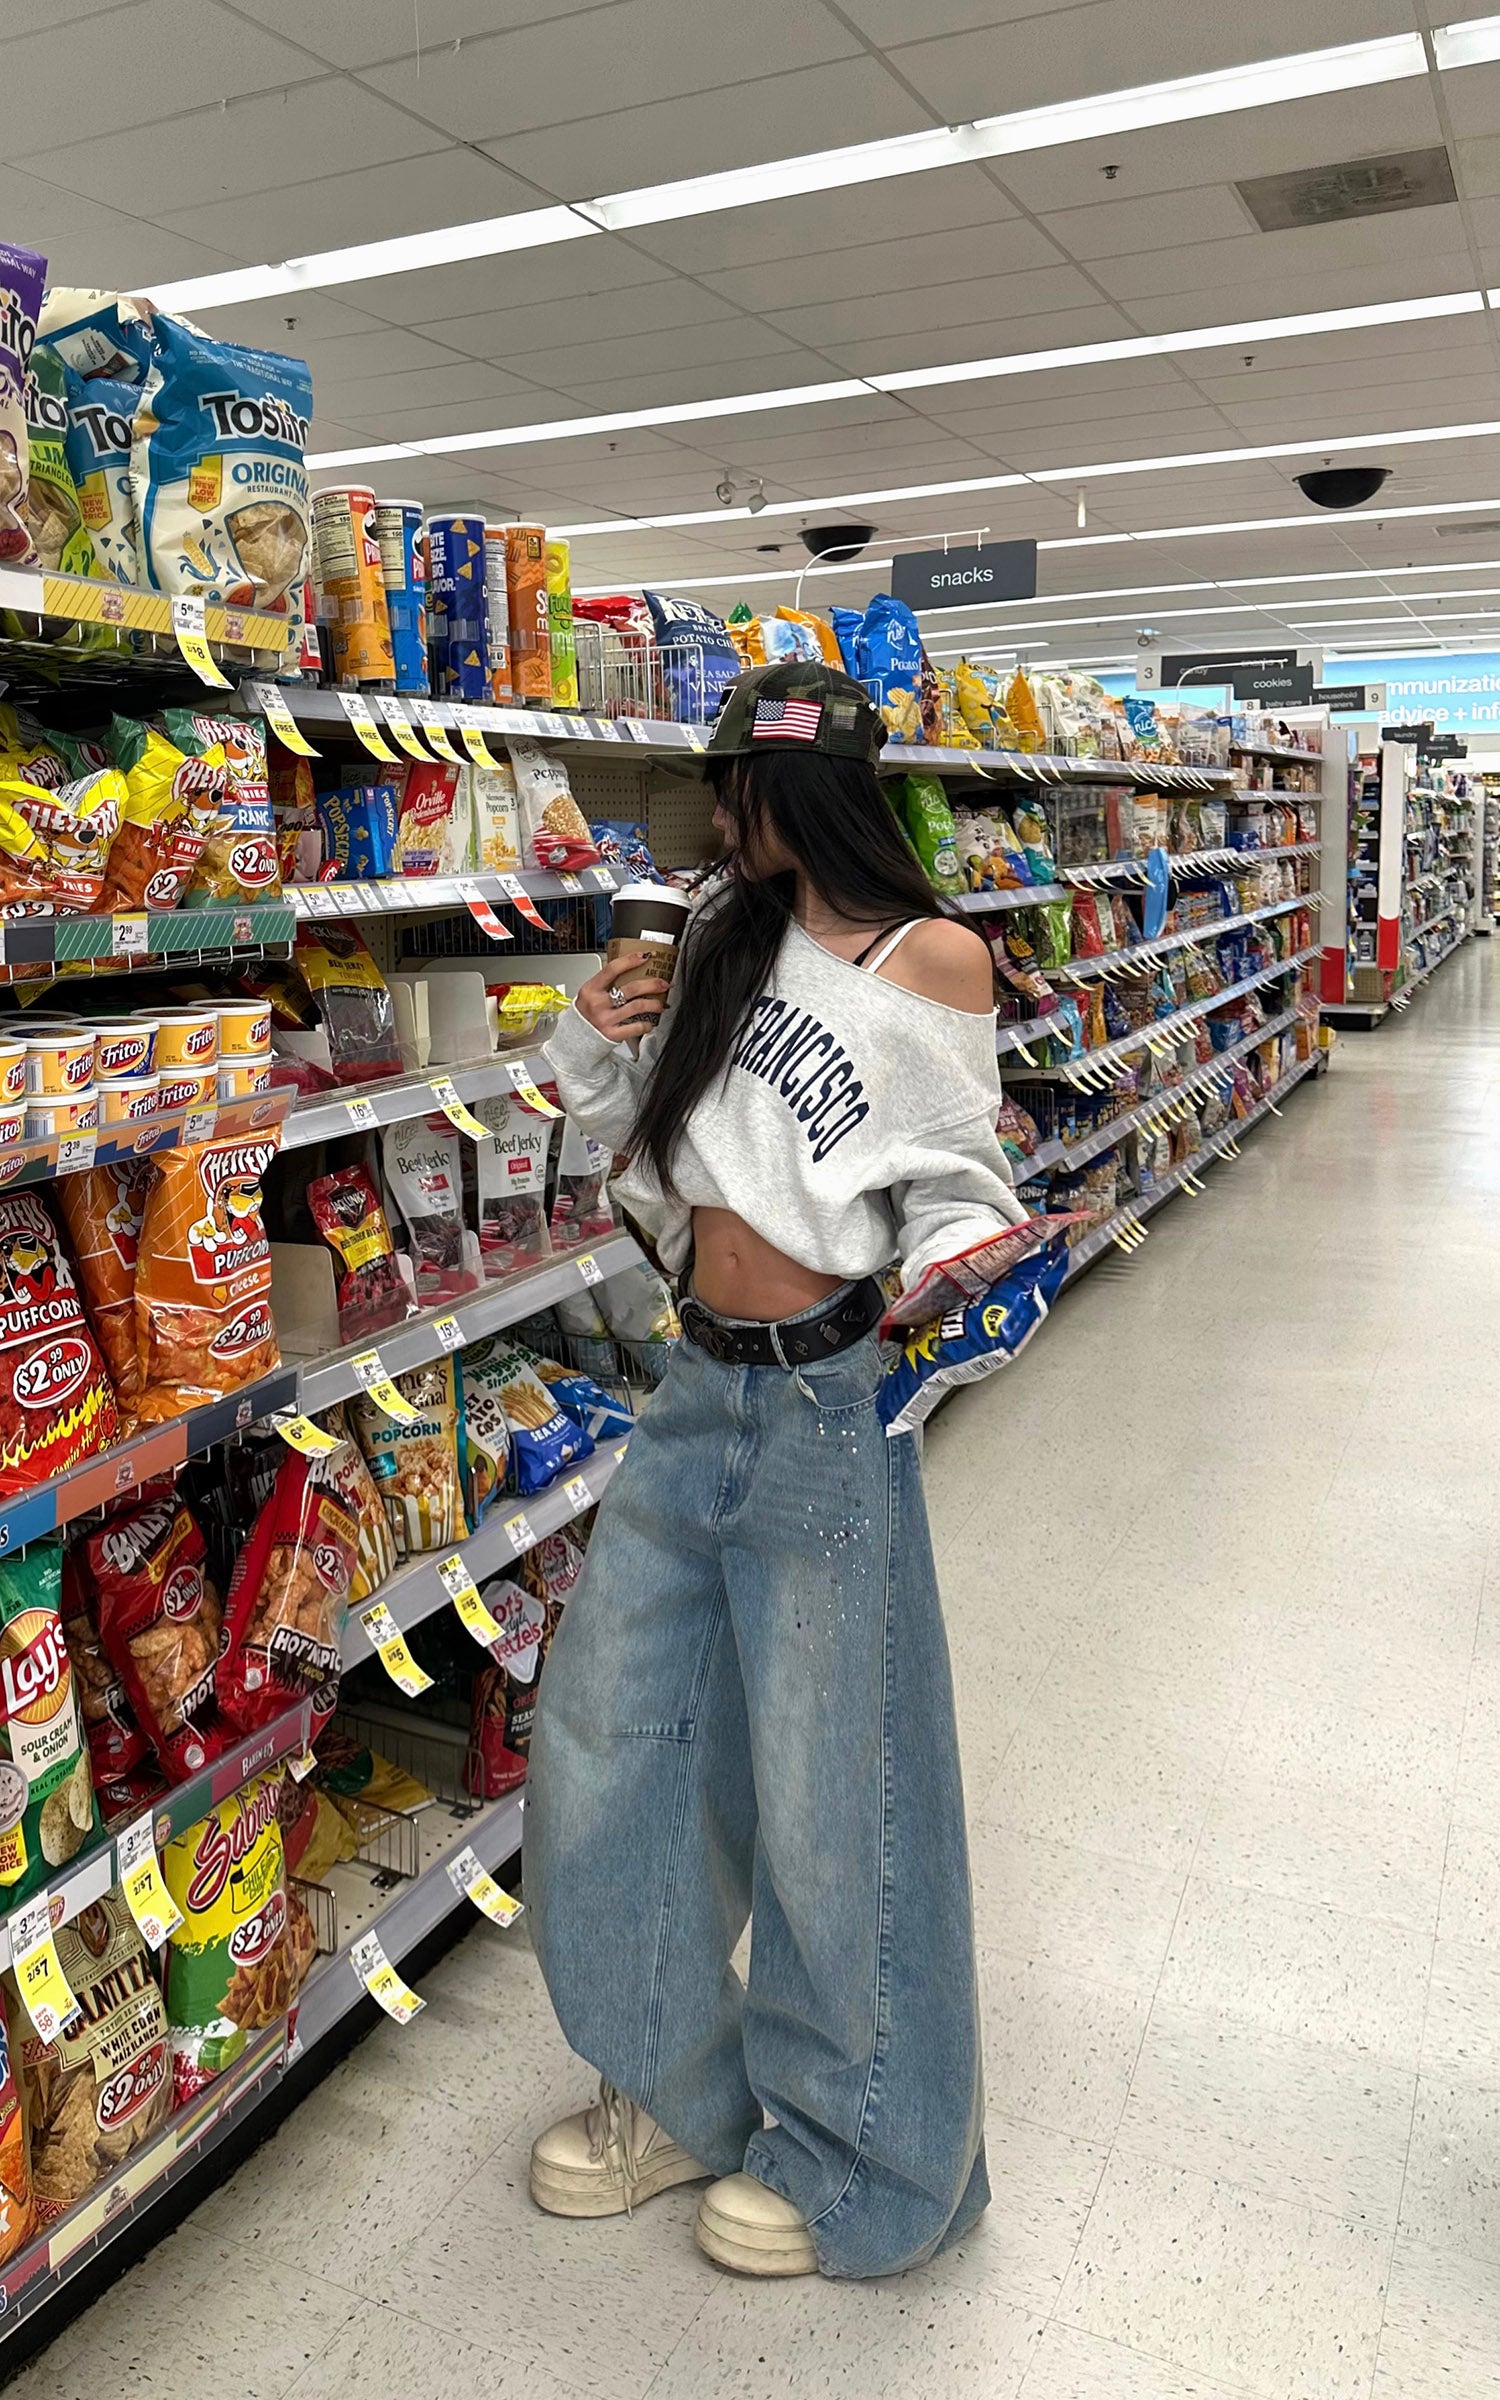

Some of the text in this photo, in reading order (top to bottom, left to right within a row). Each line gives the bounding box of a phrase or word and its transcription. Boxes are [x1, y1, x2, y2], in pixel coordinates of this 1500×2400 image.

[931, 566, 994, 589] snacks
[672, 633, 714, 646] POTATO
[1144, 667, 1154, 679] 3
[1252, 676, 1293, 689] cookies
[1246, 701, 1255, 711] 8
[1371, 692, 1379, 703] 9
[1378, 705, 1449, 725] advice
[416, 791, 447, 810] Orville
[486, 802, 509, 814] Popcorn
[101, 1039, 145, 1069] Fritos
[732, 995, 870, 1163] FRANCISCO
[160, 1080, 199, 1107] Fritos
[137, 1127, 161, 1149] Fritos
[494, 1132, 542, 1156] Beef Jerky
[214, 1240, 270, 1273] PUFFCORN
[246, 1322, 272, 1342] ONLY
[53, 1355, 87, 1384] ONLY
[486, 1365, 522, 1390] Straws
[371, 1422, 442, 1444] POPCORN
[530, 1428, 551, 1442] SEA
[183, 1580, 200, 1600] ONLY
[2, 1618, 68, 1715] Lay's
[21, 1716, 72, 1756] SOUR CREAM
[33, 1733, 69, 1763] & ONION
[30, 1781, 48, 1795] REAL
[263, 1908, 284, 1939] ONLY
[100, 2006, 161, 2059] WHITE CORN
[135, 2060, 163, 2096] ONLY
